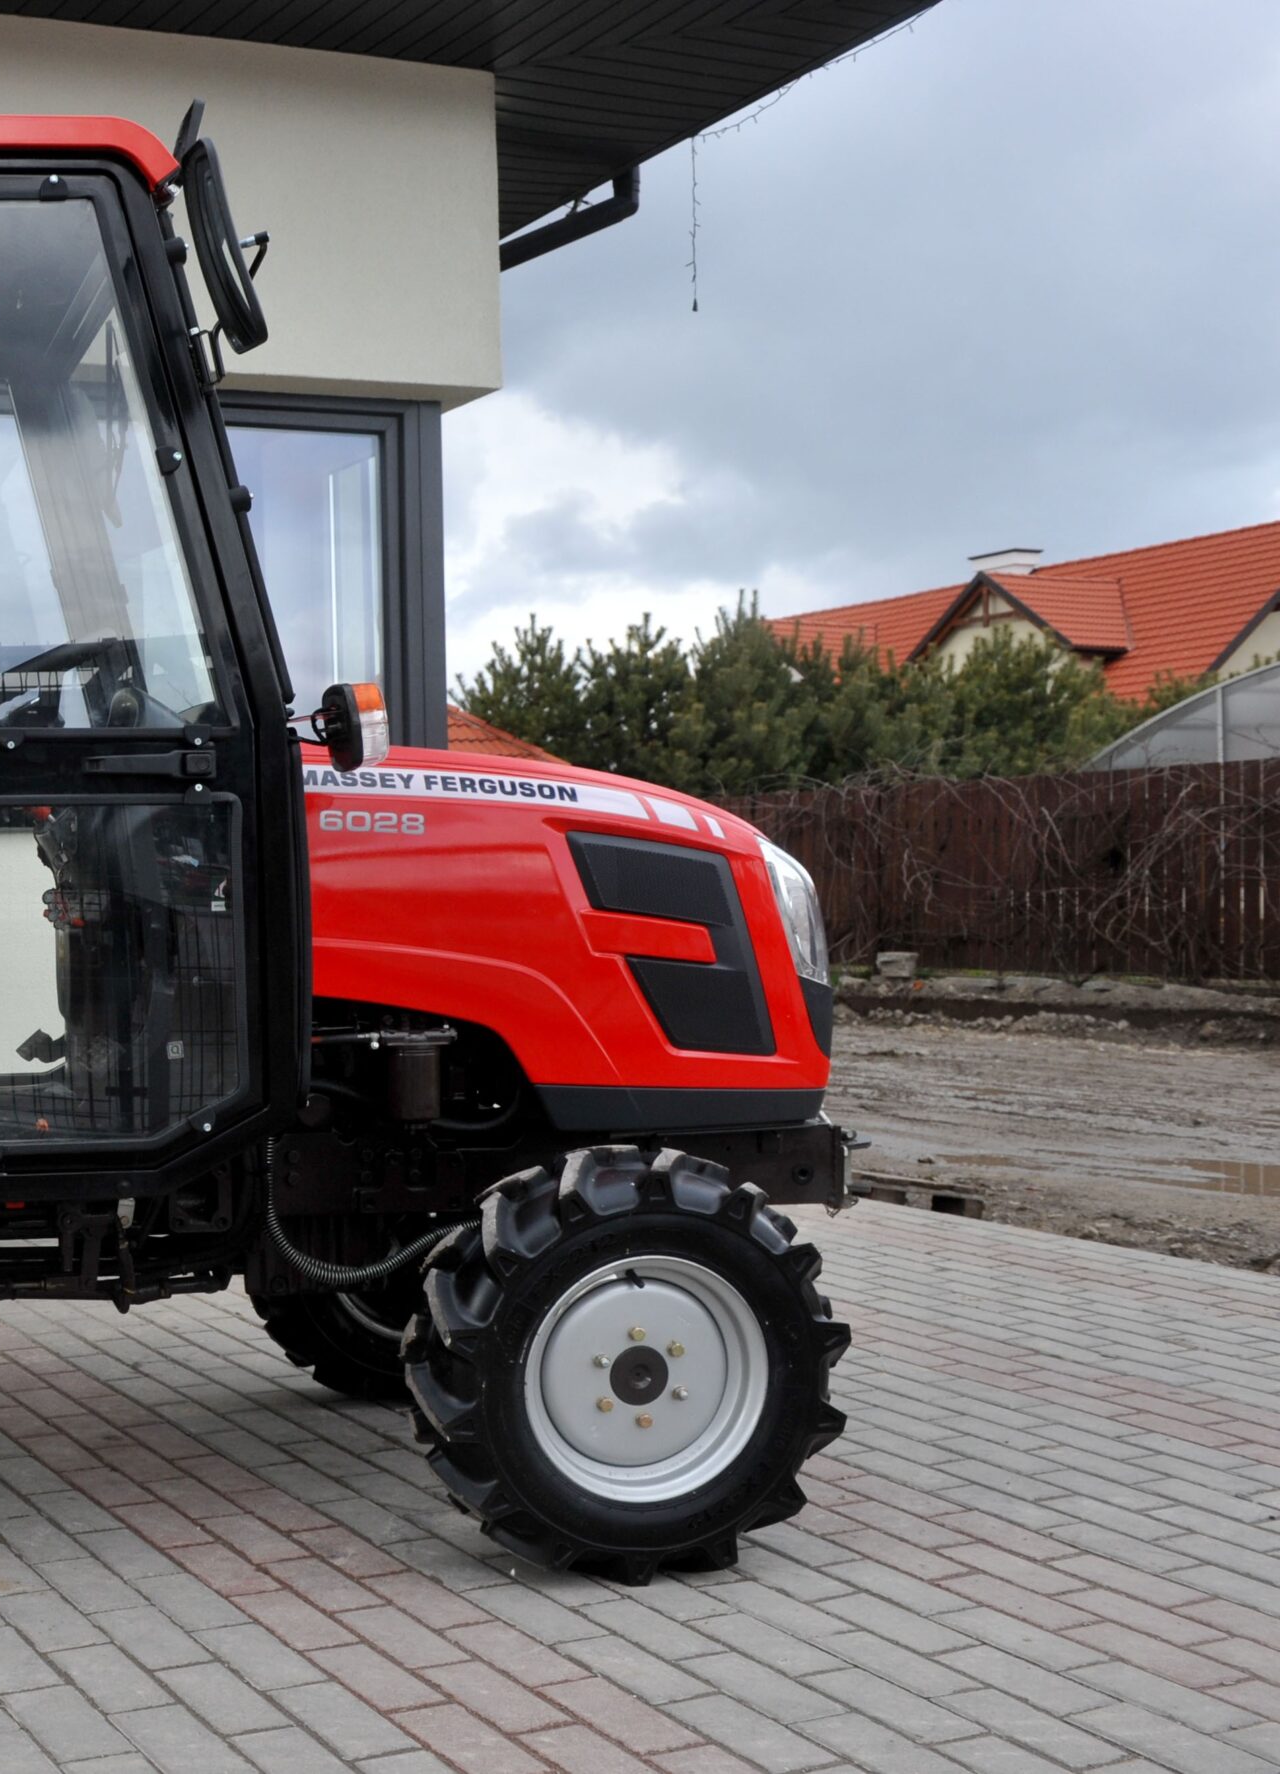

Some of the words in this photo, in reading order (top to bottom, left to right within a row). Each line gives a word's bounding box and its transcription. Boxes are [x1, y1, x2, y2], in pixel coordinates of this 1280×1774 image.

[303, 770, 414, 789] MASSEY
[424, 775, 578, 802] FERGUSON
[320, 810, 425, 835] 6028
